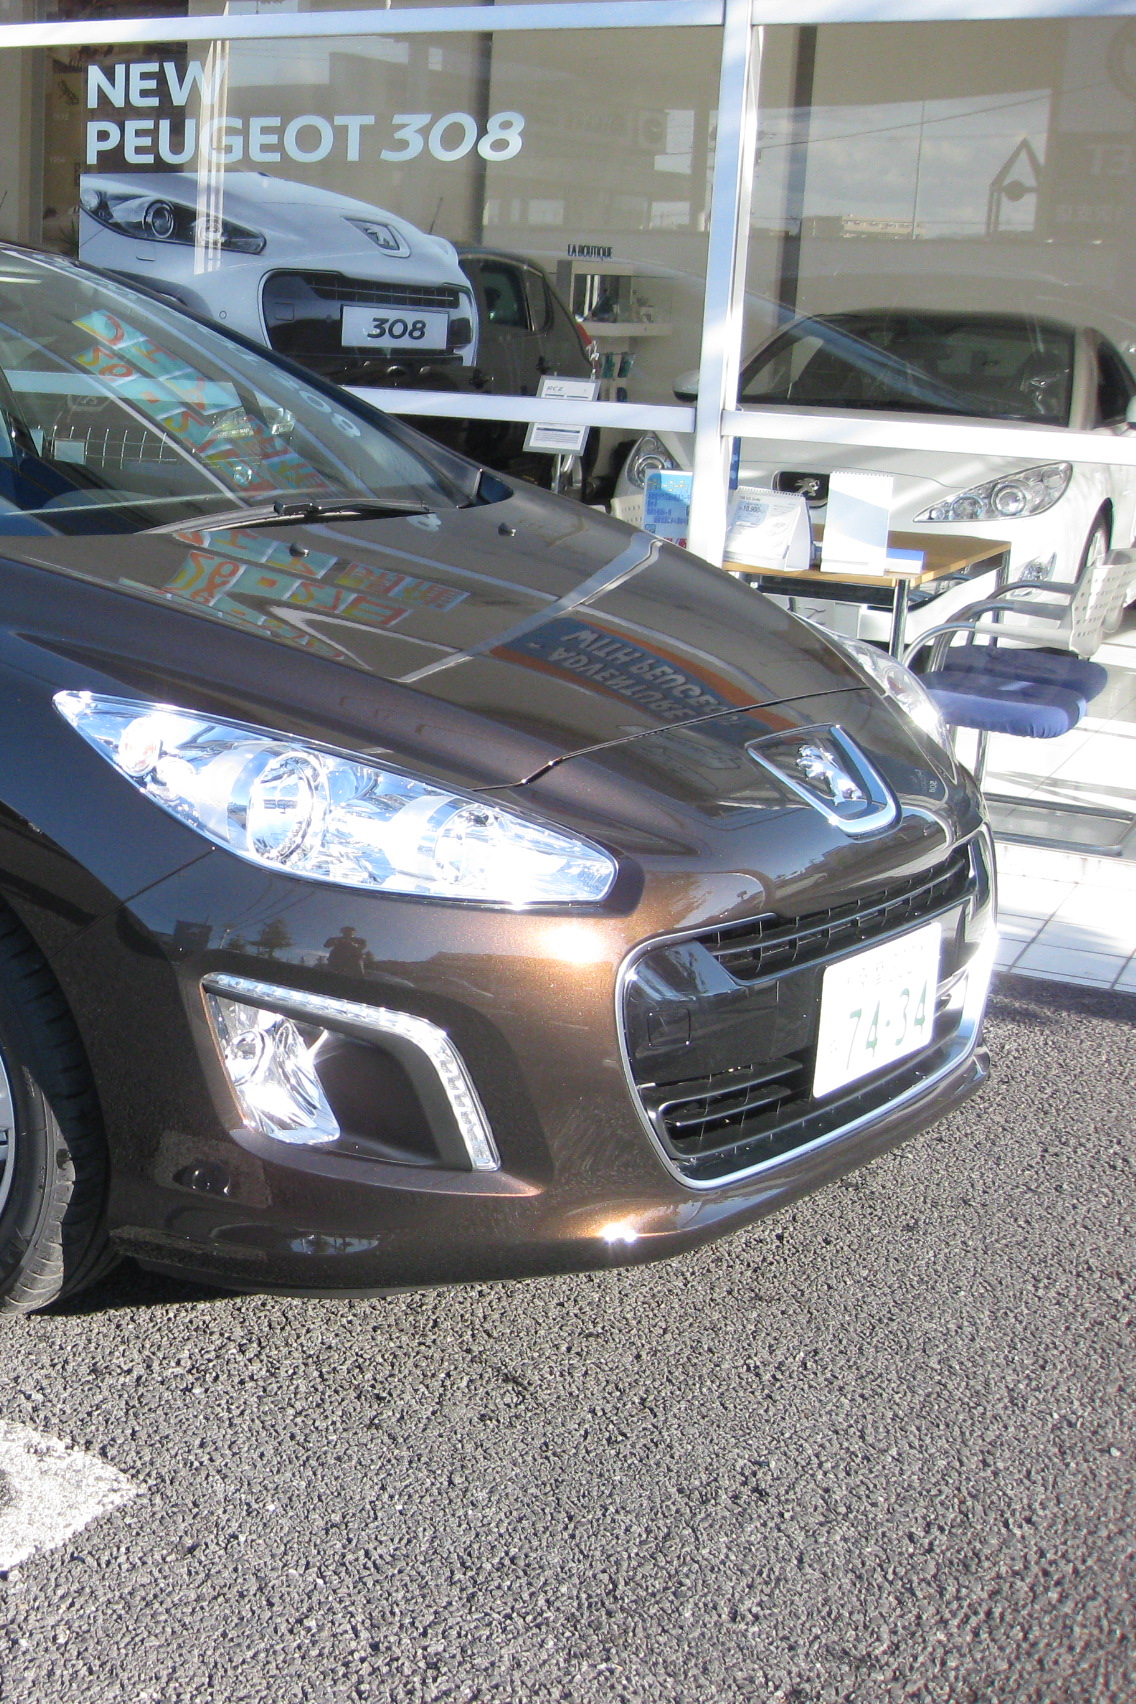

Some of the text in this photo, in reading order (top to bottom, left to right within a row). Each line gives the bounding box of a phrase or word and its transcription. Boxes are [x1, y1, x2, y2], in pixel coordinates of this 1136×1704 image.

[87, 60, 228, 109] NEW
[86, 111, 525, 164] PEUGEOT 308
[567, 244, 577, 257] LA
[367, 317, 427, 340] 308
